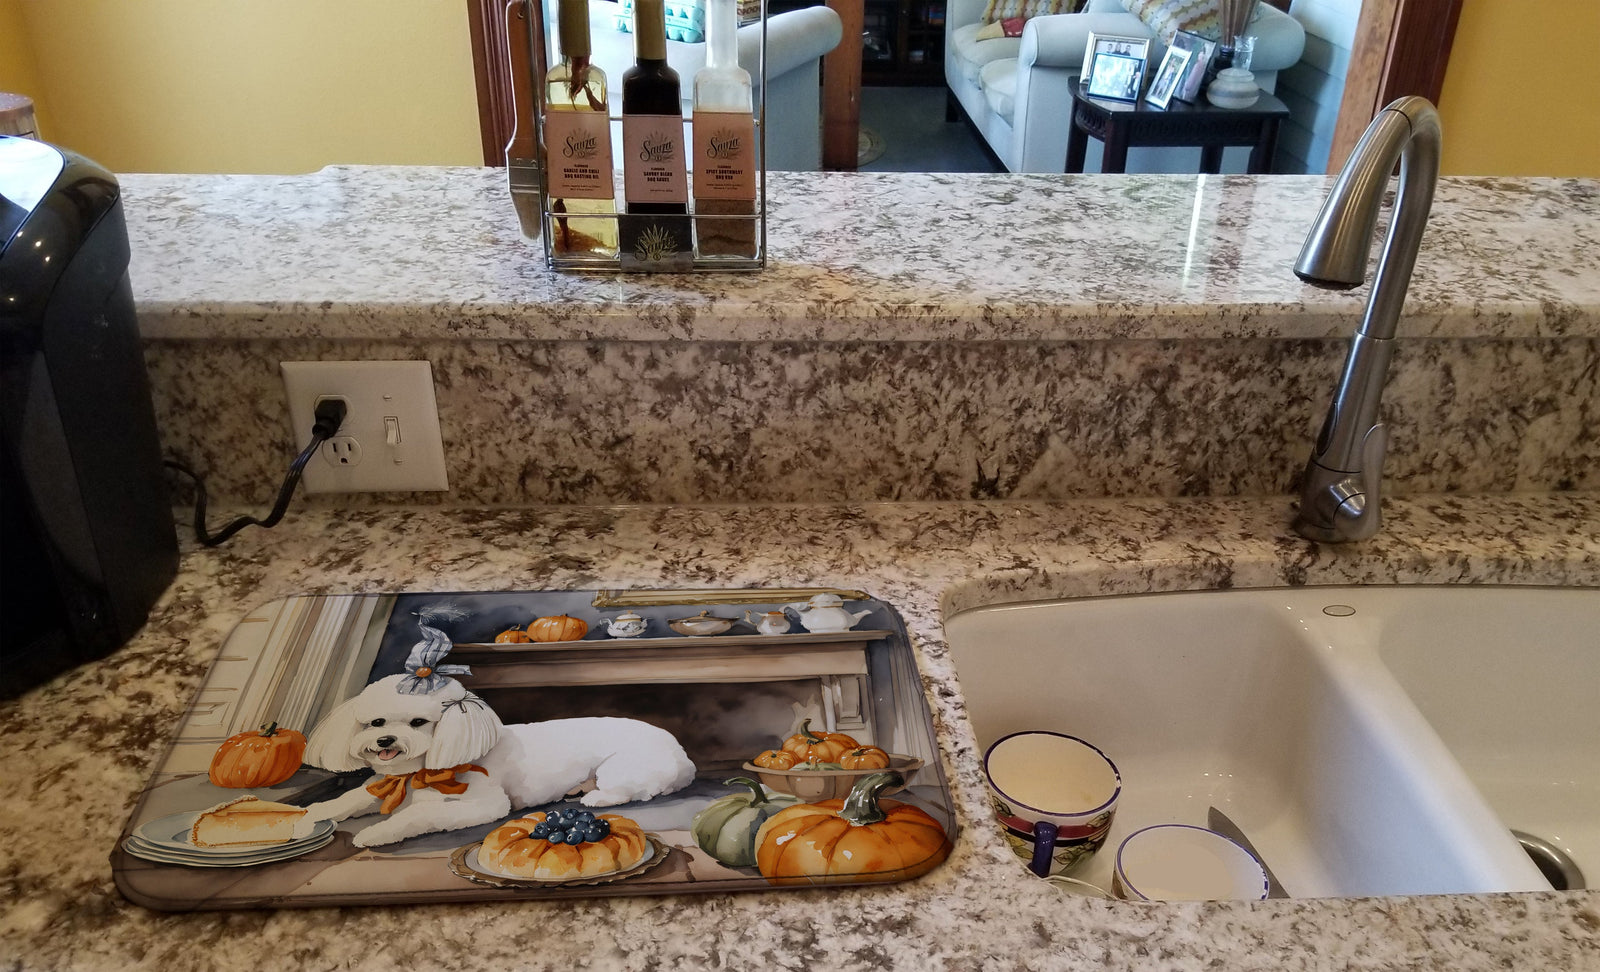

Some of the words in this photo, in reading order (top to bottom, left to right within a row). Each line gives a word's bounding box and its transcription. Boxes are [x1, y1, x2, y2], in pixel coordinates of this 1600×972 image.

[563, 135, 598, 158] Sauza
[640, 140, 674, 162] Sauza
[707, 136, 741, 159] Sauza
